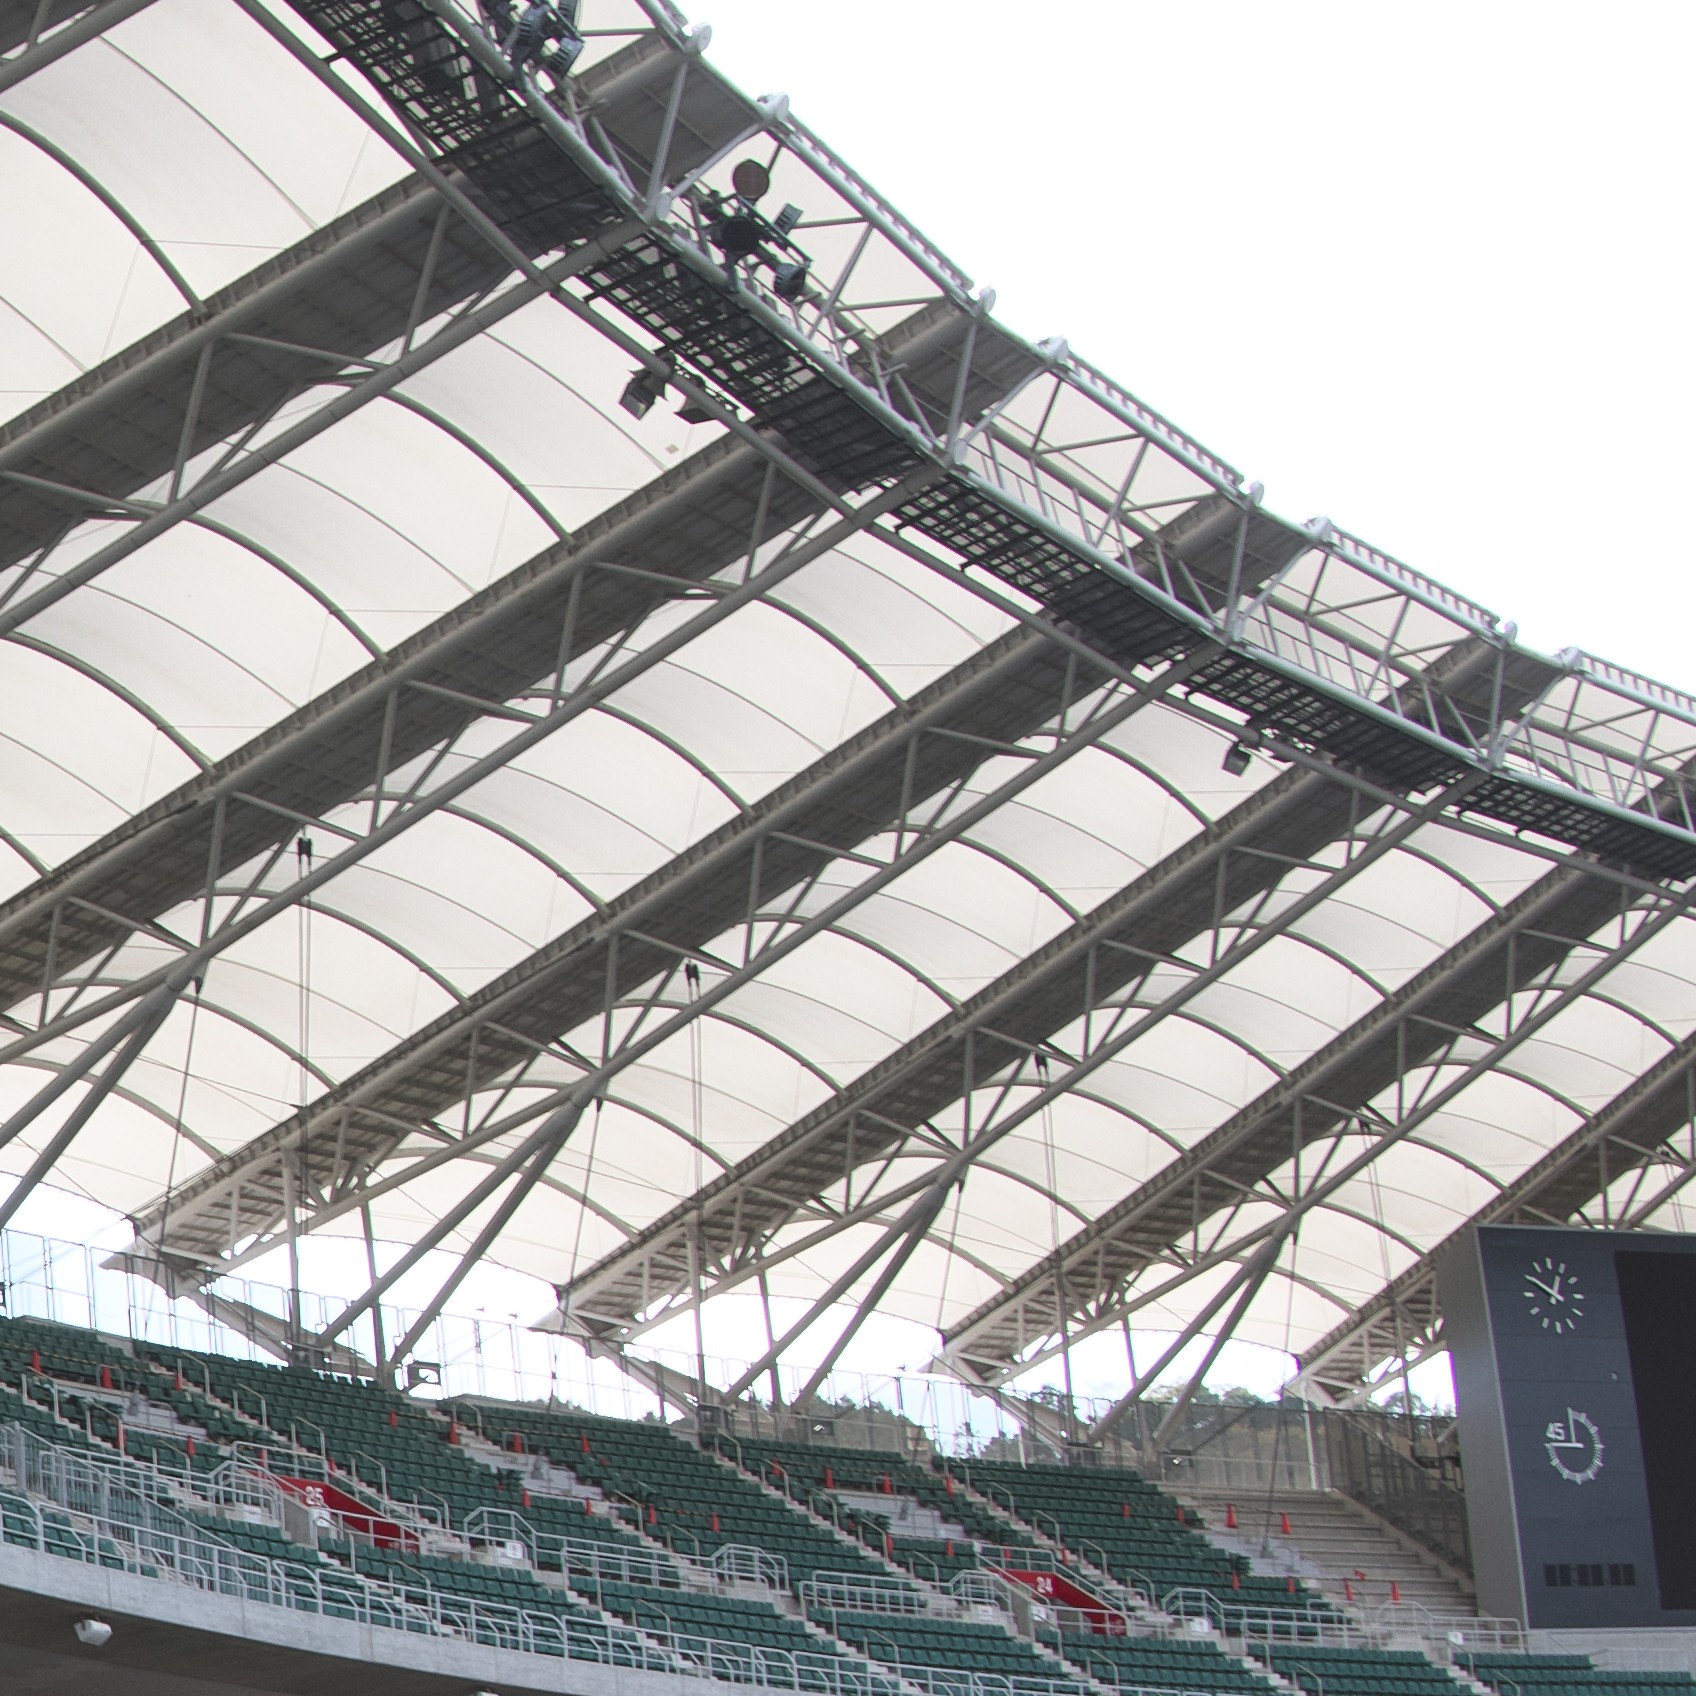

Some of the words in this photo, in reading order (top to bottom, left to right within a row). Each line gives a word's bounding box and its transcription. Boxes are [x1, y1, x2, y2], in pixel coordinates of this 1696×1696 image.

[1546, 1422, 1565, 1441] 45
[305, 1486, 324, 1506] 25
[1036, 1576, 1053, 1594] 24
